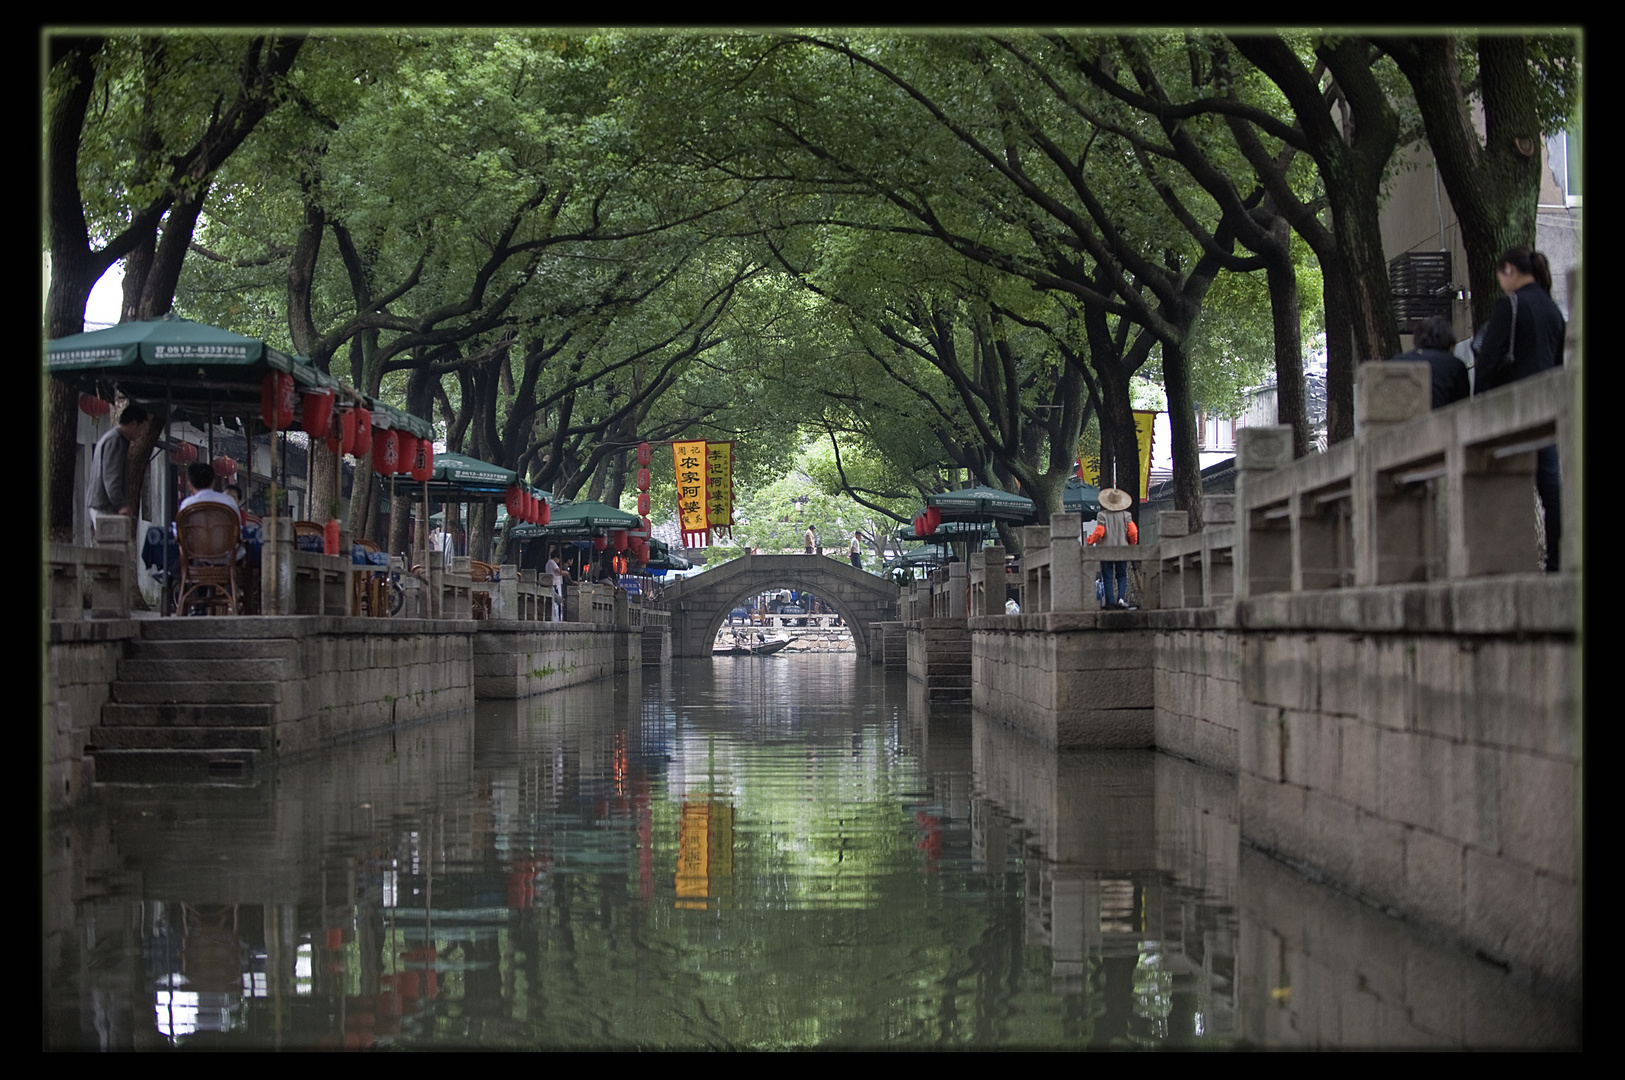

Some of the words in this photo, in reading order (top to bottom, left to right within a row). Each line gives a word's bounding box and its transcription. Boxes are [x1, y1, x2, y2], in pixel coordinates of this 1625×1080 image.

[680, 457, 701, 513] 农家阿婆
[708, 450, 724, 515] 李记阿婆茶
